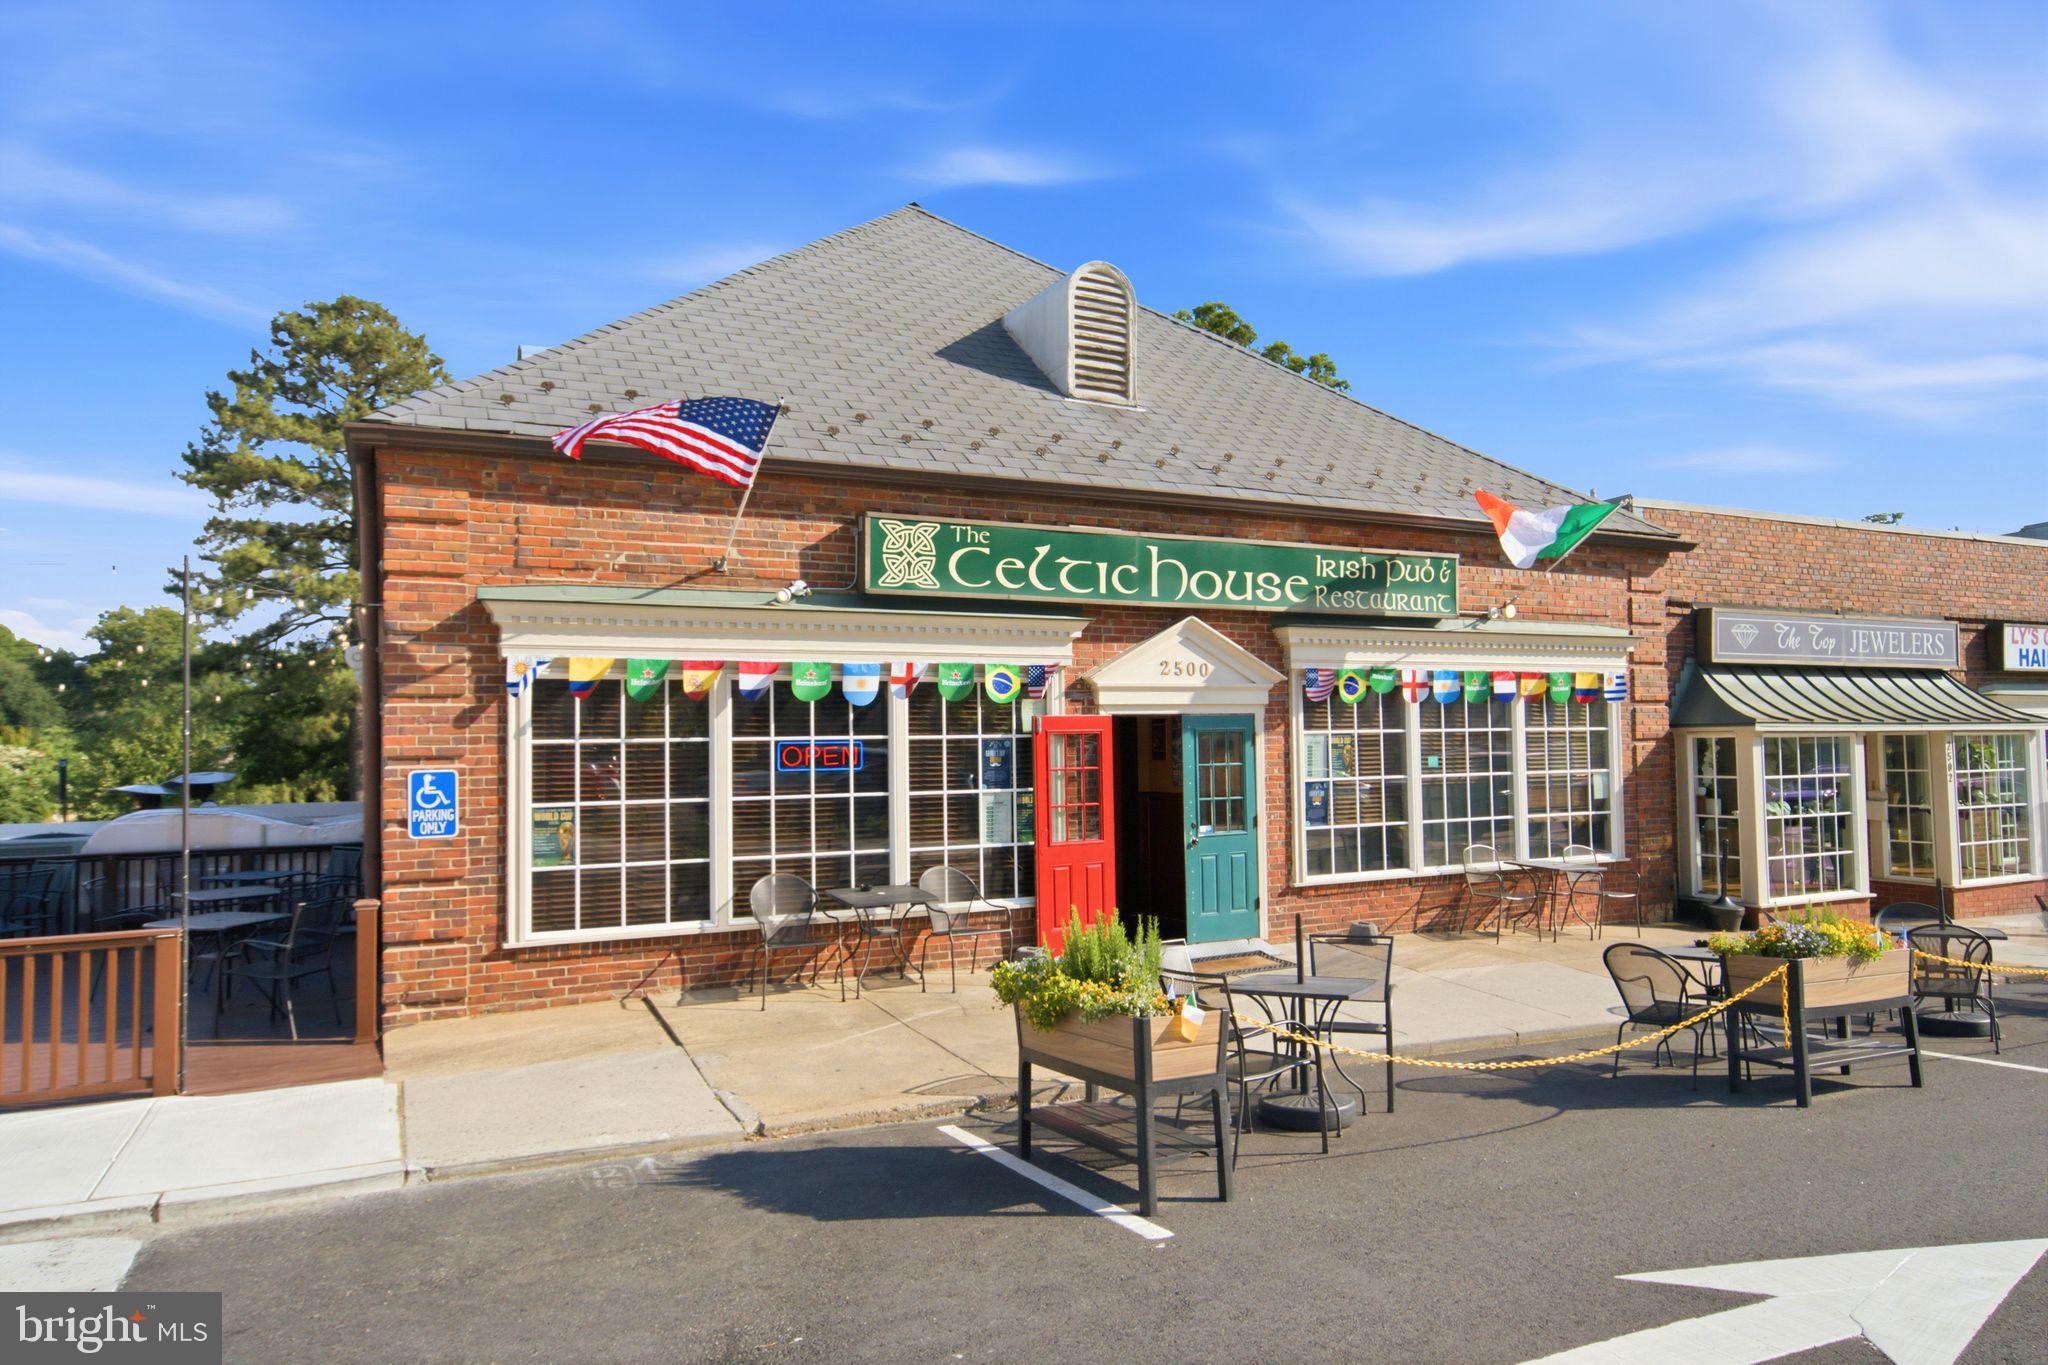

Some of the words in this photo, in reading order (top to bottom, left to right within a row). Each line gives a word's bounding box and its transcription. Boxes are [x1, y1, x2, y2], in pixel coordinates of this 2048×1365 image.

[951, 525, 990, 544] The
[948, 544, 1140, 594] Celtic
[1146, 545, 1310, 603] House
[1385, 558, 1435, 587] Pub
[1440, 559, 1452, 583] &
[1314, 584, 1451, 613] Restaurant
[1774, 622, 1801, 649] The
[1808, 623, 1836, 654] Top
[1850, 629, 1945, 656] JEWELERS
[2011, 624, 2039, 645] LY'S
[2019, 648, 2048, 667] HAI
[1160, 659, 1209, 678] 2500
[782, 745, 859, 767] OPEN
[412, 808, 455, 822] PARKING
[420, 821, 448, 835] ONLY
